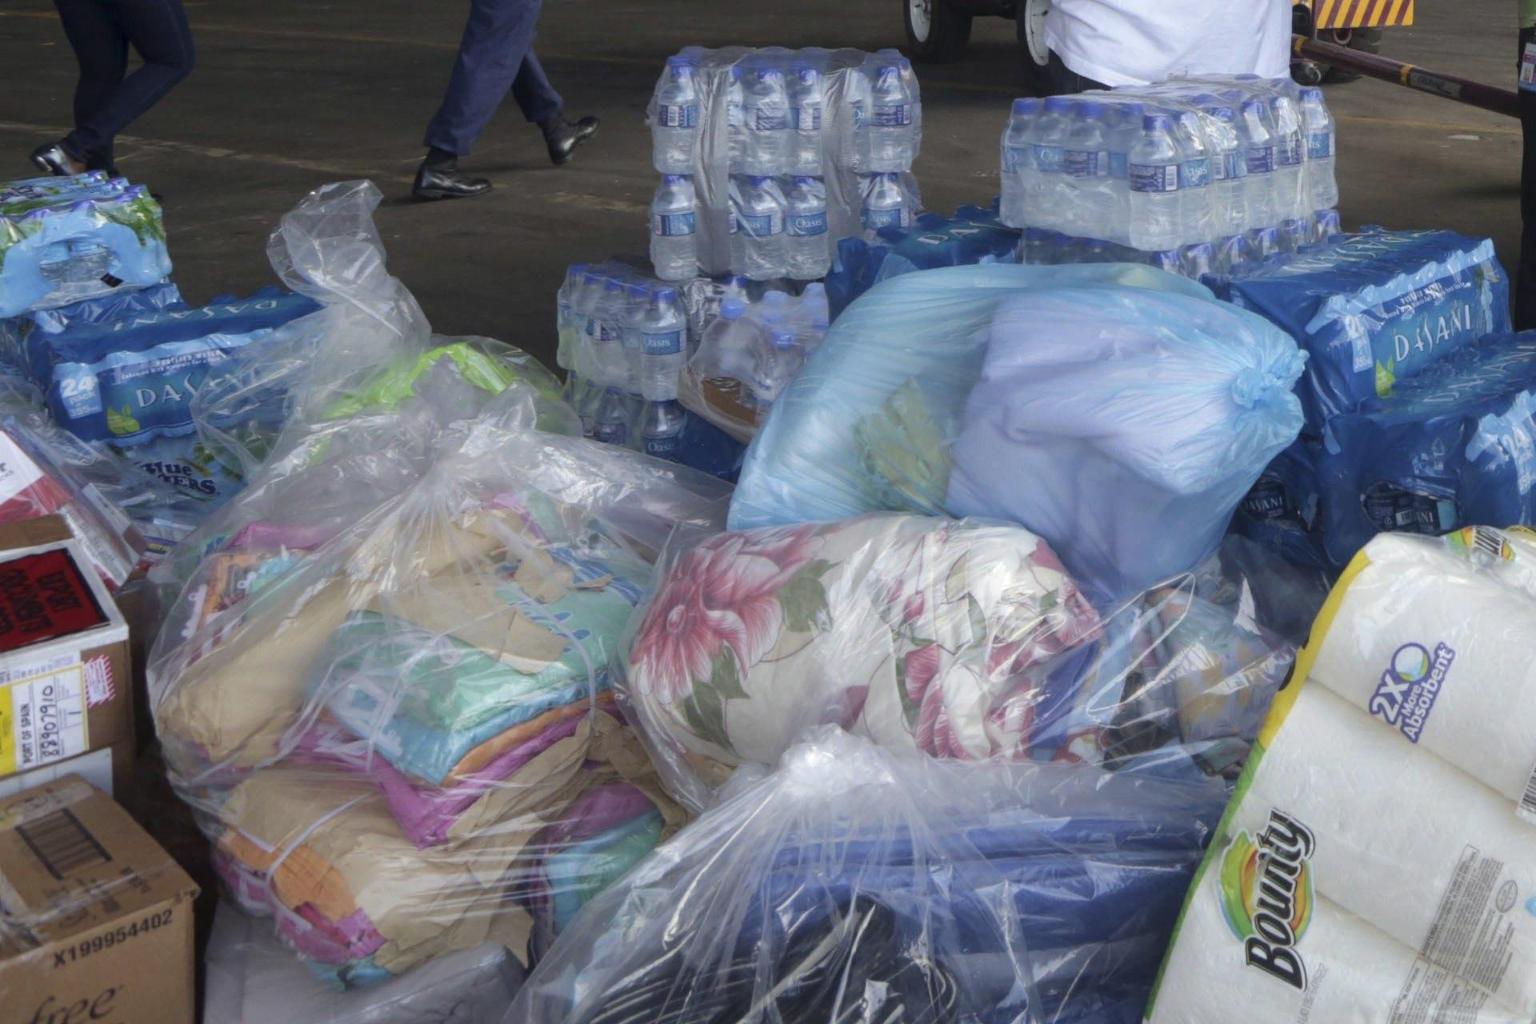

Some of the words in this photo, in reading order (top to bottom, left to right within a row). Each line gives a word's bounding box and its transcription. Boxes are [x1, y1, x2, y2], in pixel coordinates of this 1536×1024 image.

[1394, 303, 1471, 362] DASANI
[61, 375, 97, 398] 24
[160, 473, 217, 496] TERS
[1372, 673, 1410, 723] 2X
[1401, 684, 1422, 718] More
[1402, 645, 1454, 740] Absorbent
[20, 702, 31, 728] SPAIN
[21, 729, 32, 741] OF
[21, 741, 34, 764] PORT
[1246, 807, 1315, 992] Bounty
[53, 909, 174, 970] X199954402
